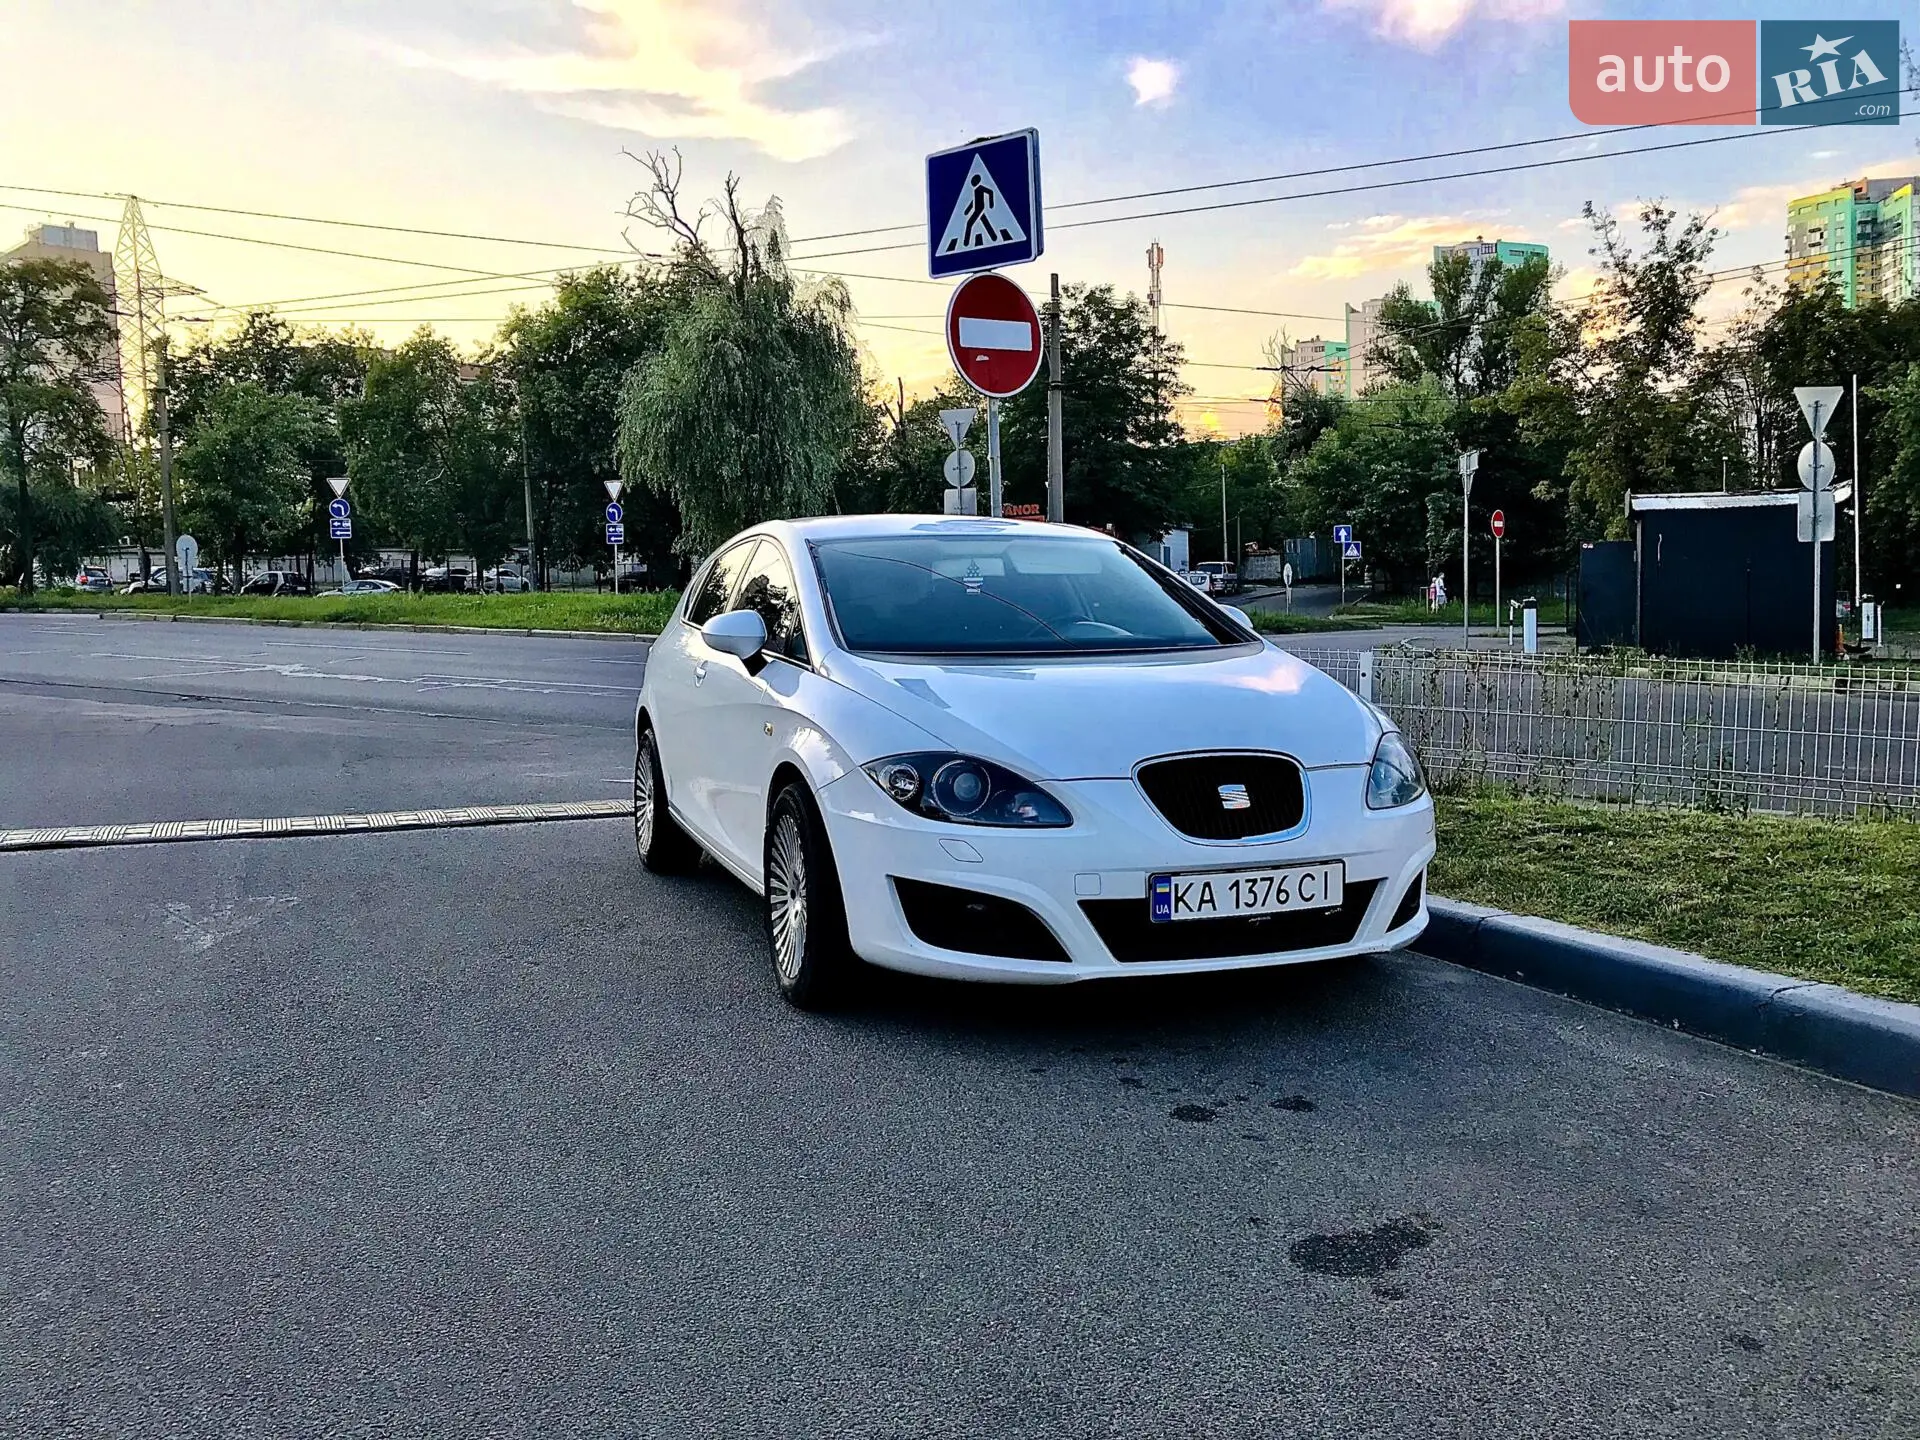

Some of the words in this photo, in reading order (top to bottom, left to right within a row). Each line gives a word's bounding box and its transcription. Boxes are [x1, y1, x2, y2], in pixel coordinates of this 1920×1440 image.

[1174, 881, 1217, 913] KA
[1228, 874, 1290, 909] 1376
[1298, 870, 1329, 903] CI
[1156, 904, 1169, 915] UA
